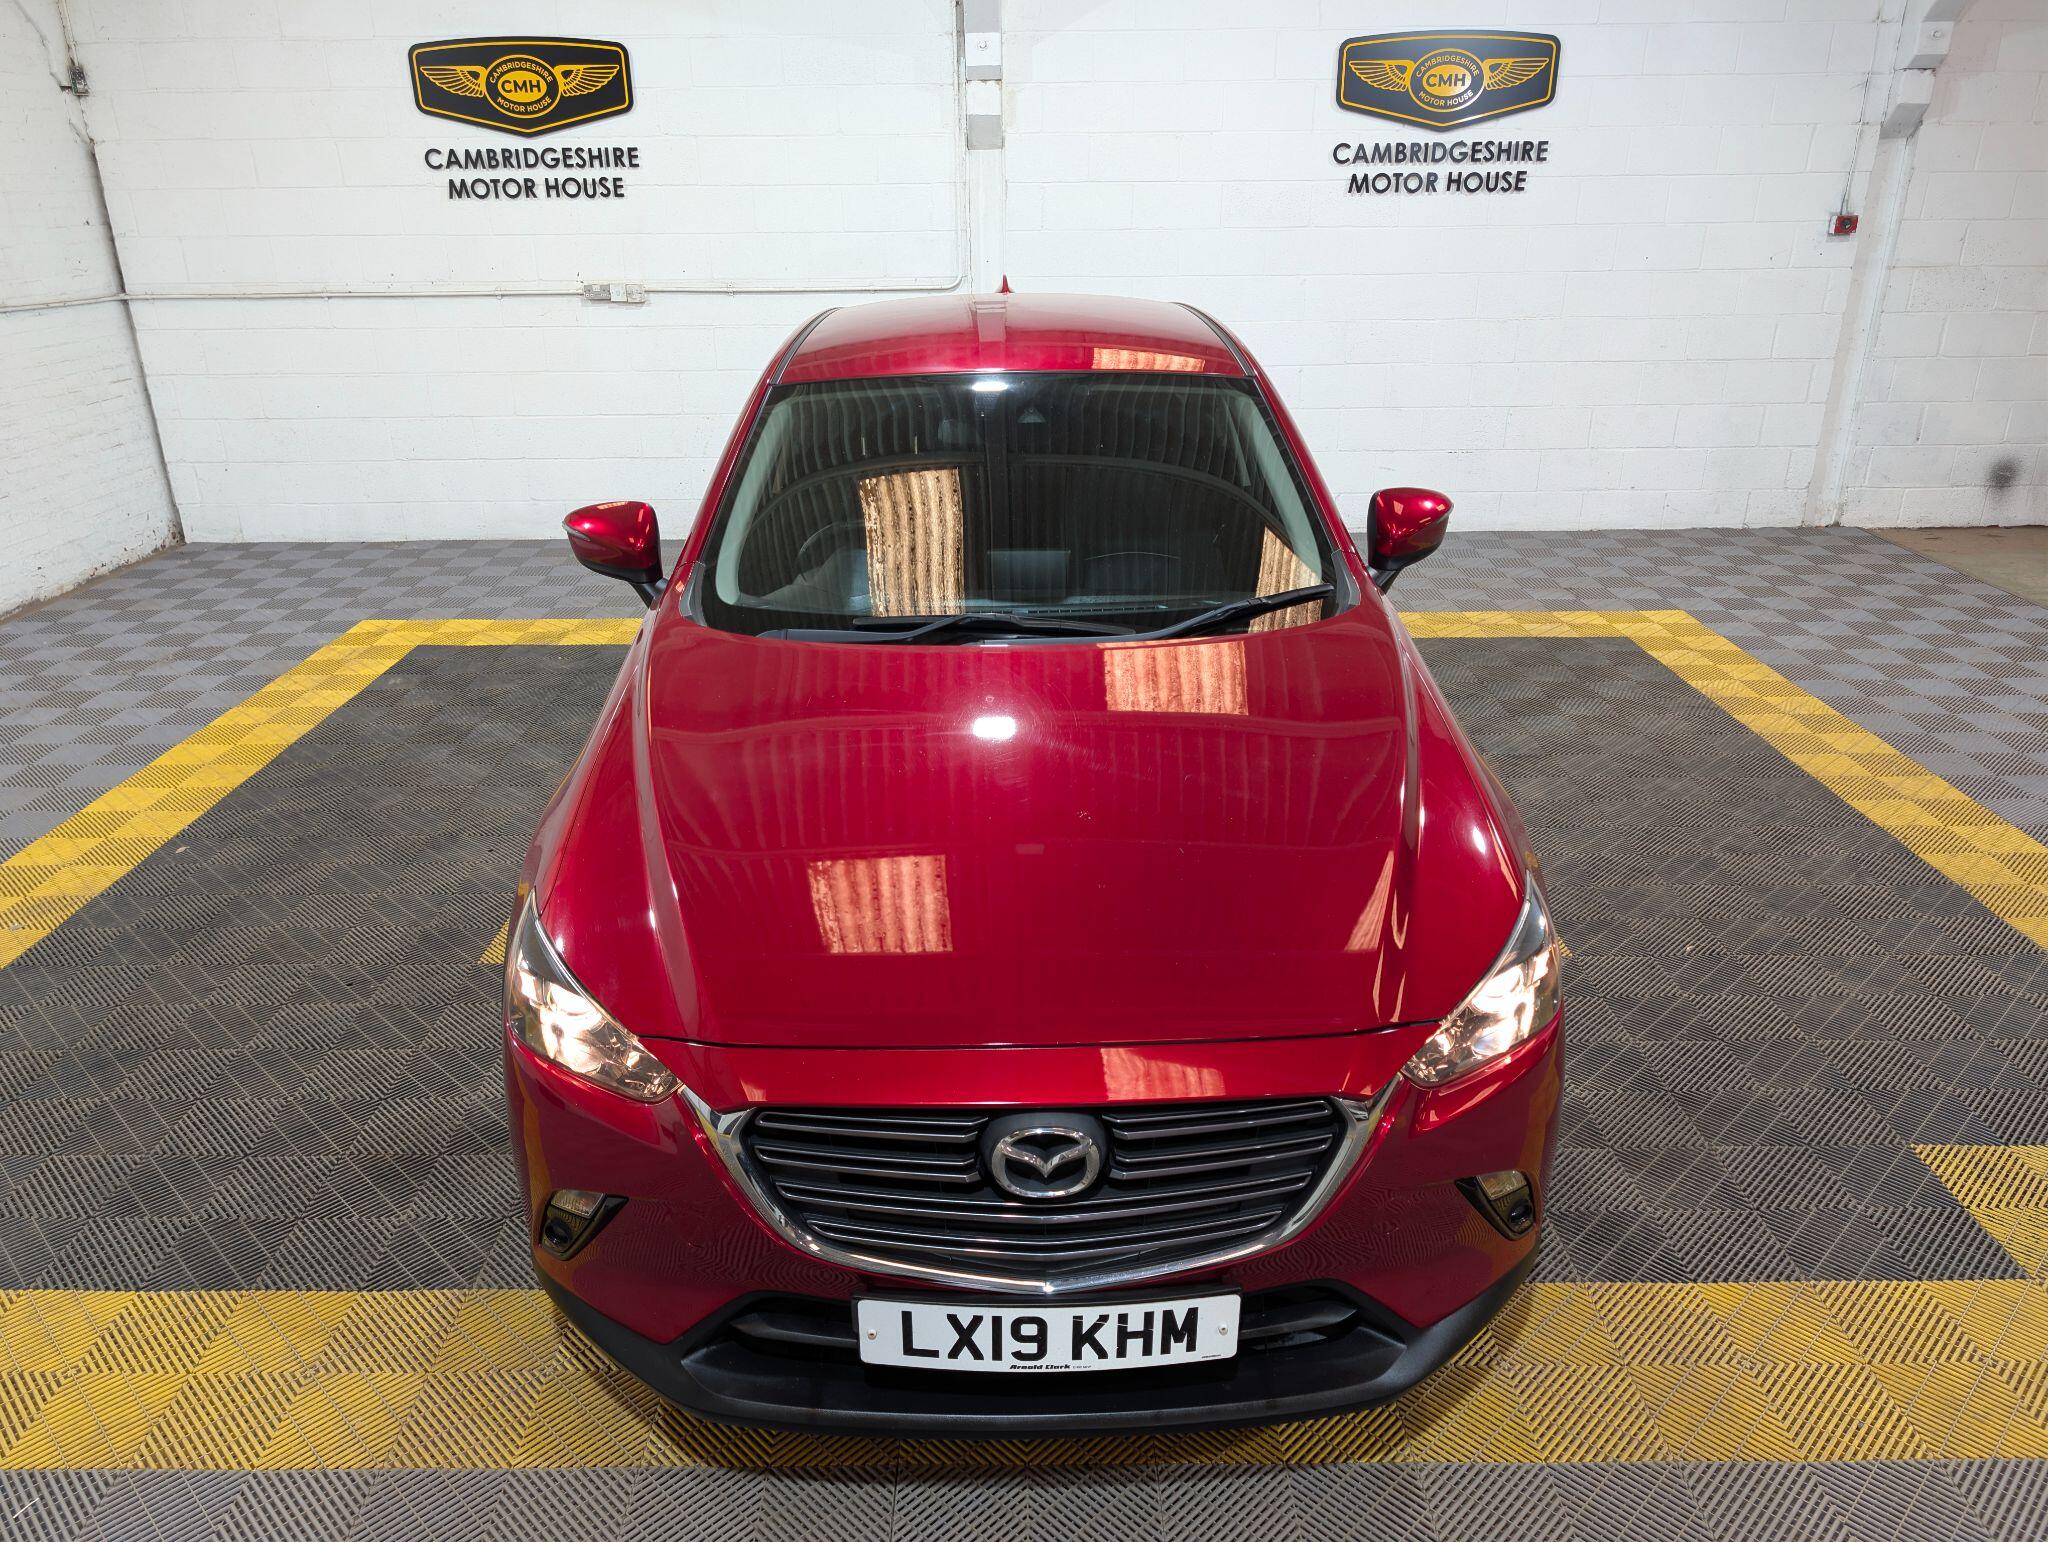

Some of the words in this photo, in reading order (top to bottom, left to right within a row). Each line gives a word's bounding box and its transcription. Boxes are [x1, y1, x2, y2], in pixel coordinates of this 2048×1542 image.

[490, 61, 554, 84] CAMBRIDGESHIRE
[1416, 55, 1479, 77] CAMBRIDGESHIRE
[501, 80, 541, 94] CMH
[1426, 74, 1466, 88] CMH
[497, 97, 526, 113] MOTOR
[527, 96, 552, 113] HOUSE
[1418, 91, 1445, 107] MOTOR
[1447, 89, 1474, 107] HOUSE
[424, 147, 640, 170] CAMBRIDGESHIRE
[1332, 140, 1549, 165] CAMBRIDGESHIRE
[448, 178, 538, 200] MOTOR
[544, 176, 625, 199] HOUSE
[1347, 172, 1438, 194] MOTOR
[1446, 170, 1528, 194] HOUSE
[901, 1310, 1048, 1361] LX19
[1071, 1306, 1199, 1361] KHM
